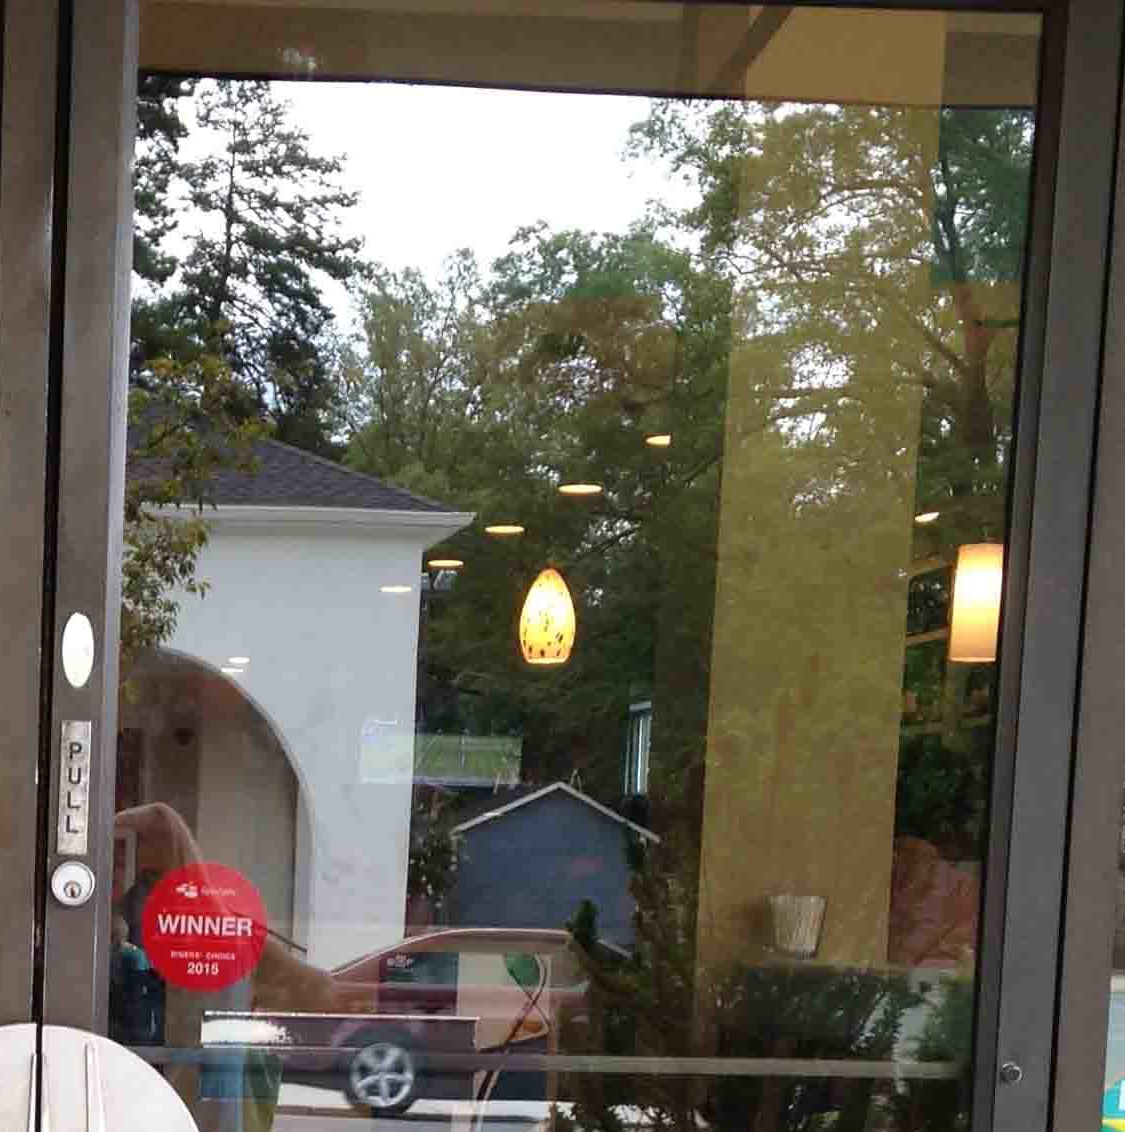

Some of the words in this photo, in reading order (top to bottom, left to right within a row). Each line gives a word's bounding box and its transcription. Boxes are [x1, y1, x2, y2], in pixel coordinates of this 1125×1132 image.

[65, 741, 83, 835] PULL
[157, 912, 253, 937] WINNER
[186, 961, 220, 976] 2015
